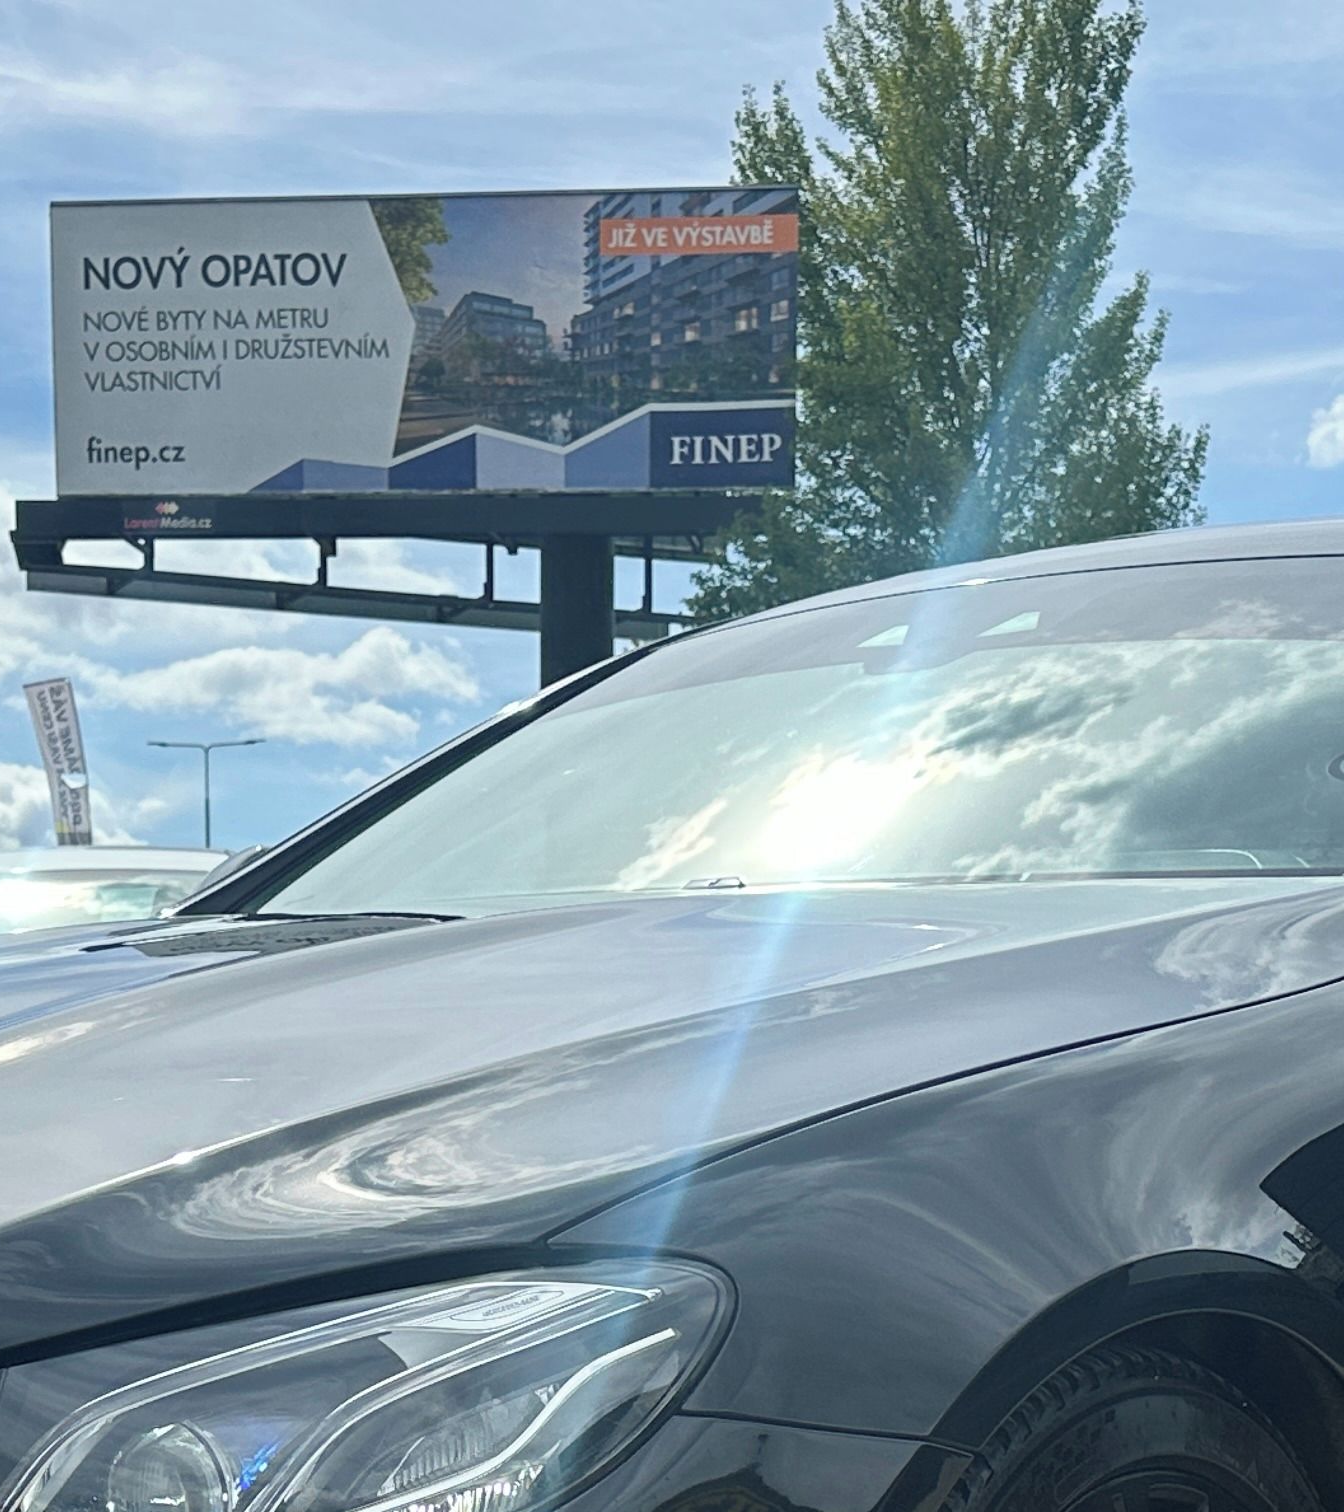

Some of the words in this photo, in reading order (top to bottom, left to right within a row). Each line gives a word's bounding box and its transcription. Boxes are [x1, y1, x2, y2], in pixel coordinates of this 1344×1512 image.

[607, 219, 637, 249] JIŽ
[642, 226, 667, 247] VE
[671, 218, 774, 247] VÝSTAVBĚ
[83, 247, 190, 291] NOVÝ
[201, 253, 347, 288] OPATOV
[83, 306, 151, 332] NOVÉ
[157, 310, 207, 331] BYTY
[215, 309, 248, 330] NA
[257, 307, 329, 329] METRU
[83, 341, 99, 361] V
[106, 336, 216, 362] OSOBNÍM
[237, 333, 389, 360] DRUŽSTEVNÍM
[85, 364, 221, 393] VLASTNICTVÍ
[87, 436, 186, 469] finep.cz
[670, 433, 782, 466] FINEP
